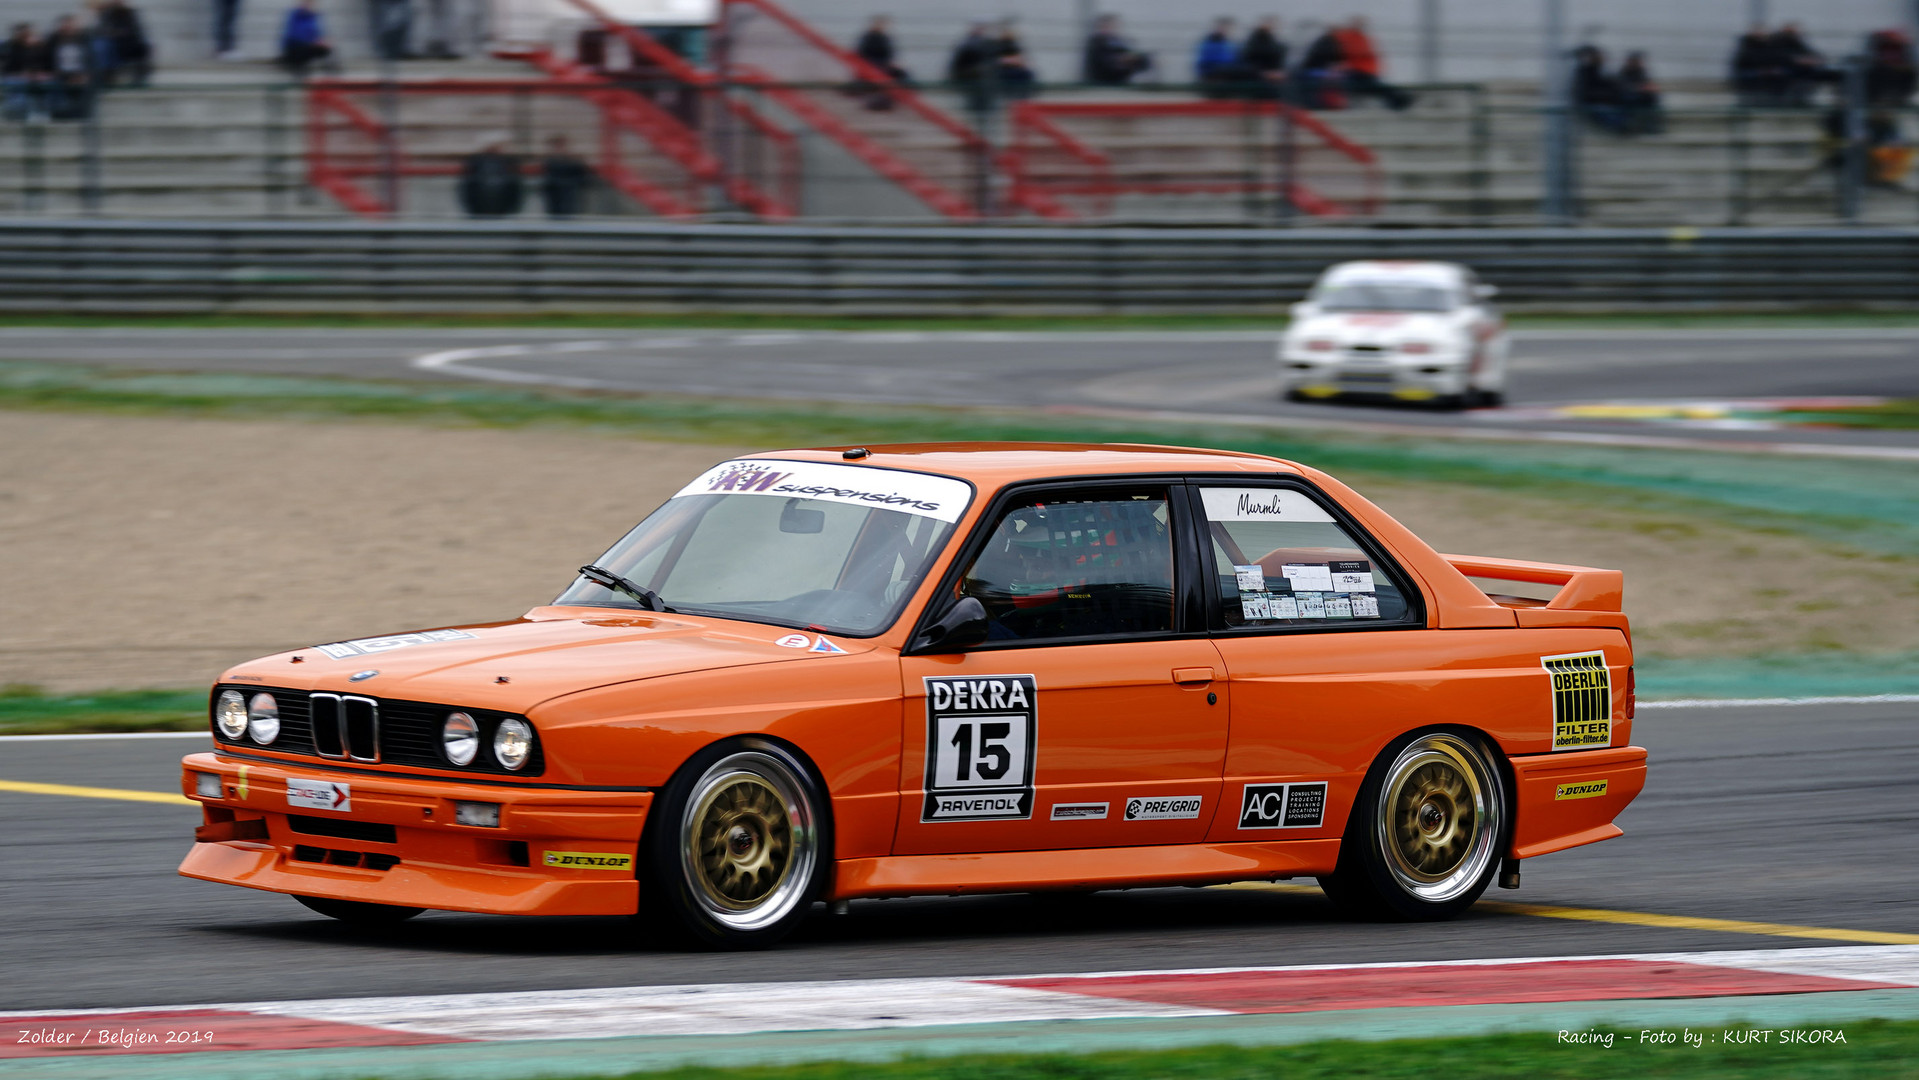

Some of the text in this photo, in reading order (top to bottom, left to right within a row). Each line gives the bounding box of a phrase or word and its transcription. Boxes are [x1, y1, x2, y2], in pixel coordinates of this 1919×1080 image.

[708, 470, 941, 511] KW suspensions
[1237, 493, 1281, 516] Murmli
[784, 638, 803, 647] E
[1554, 671, 1608, 690] OBERLIN
[932, 679, 1029, 710] DEKRA
[1556, 723, 1608, 735] FILTER
[1556, 733, 1608, 745] oberlin-filter.de
[951, 722, 1011, 781] 15
[1565, 783, 1607, 795] DUNLOP
[941, 799, 1015, 812] RAVENOL
[1143, 800, 1200, 813] PRE/GRID
[1243, 792, 1280, 820] AC
[559, 856, 630, 866] DUNLOP
